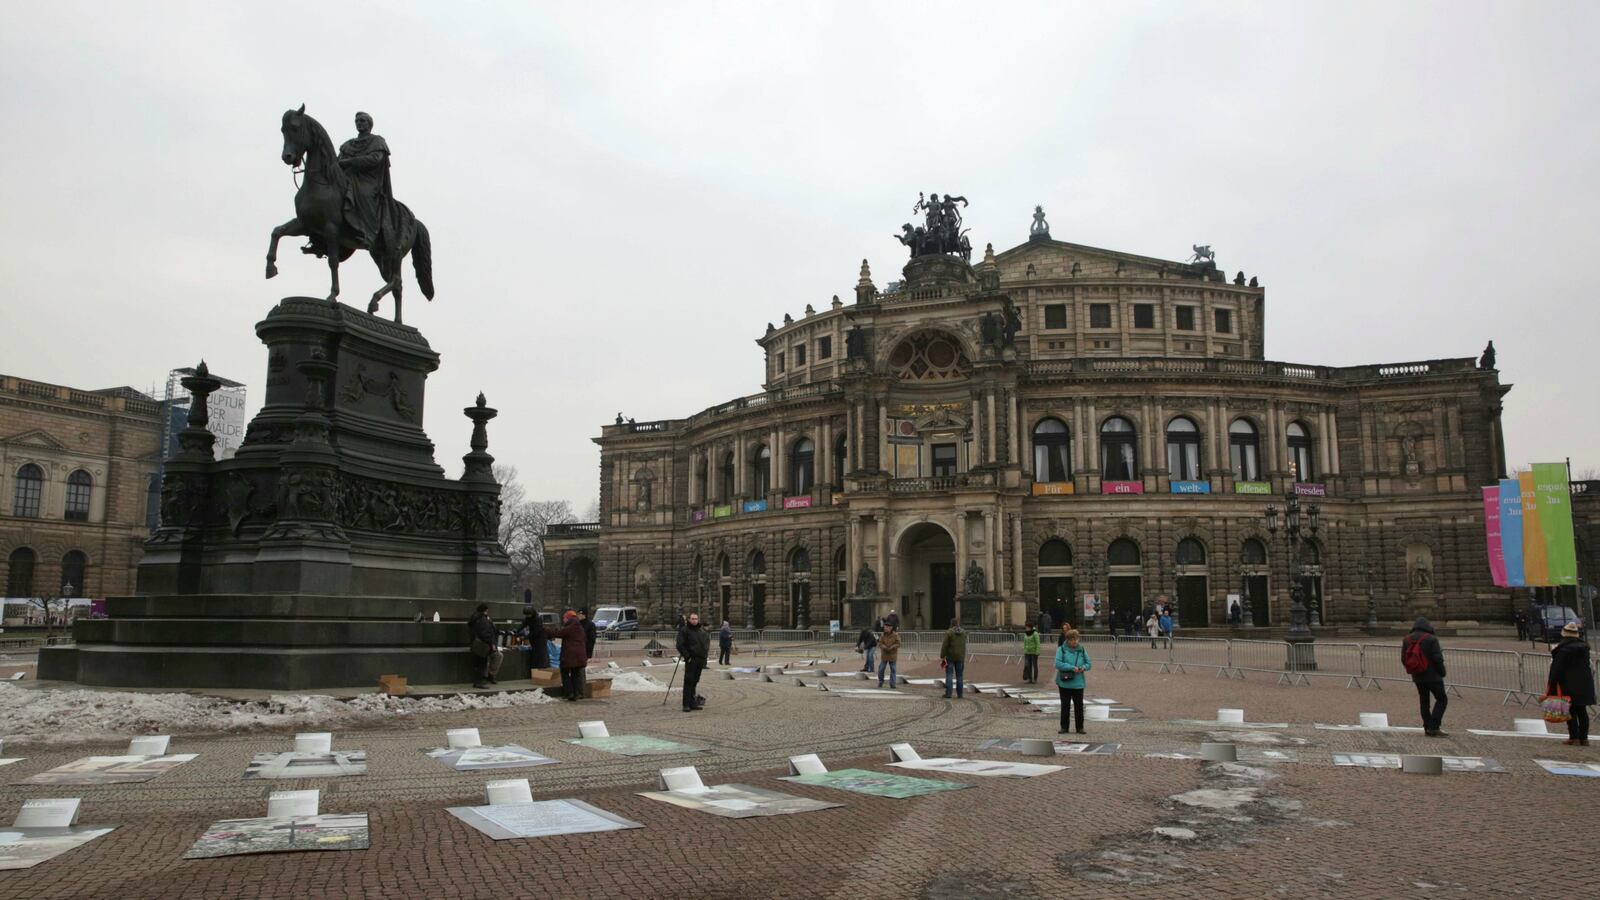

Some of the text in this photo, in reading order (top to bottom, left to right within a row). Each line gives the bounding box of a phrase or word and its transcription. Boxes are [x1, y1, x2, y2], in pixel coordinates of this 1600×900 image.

[207, 393, 244, 410] ULPTUR
[207, 421, 244, 437] MÄLDE-
[1045, 484, 1325, 495] Für ein welt- offenes Dresden
